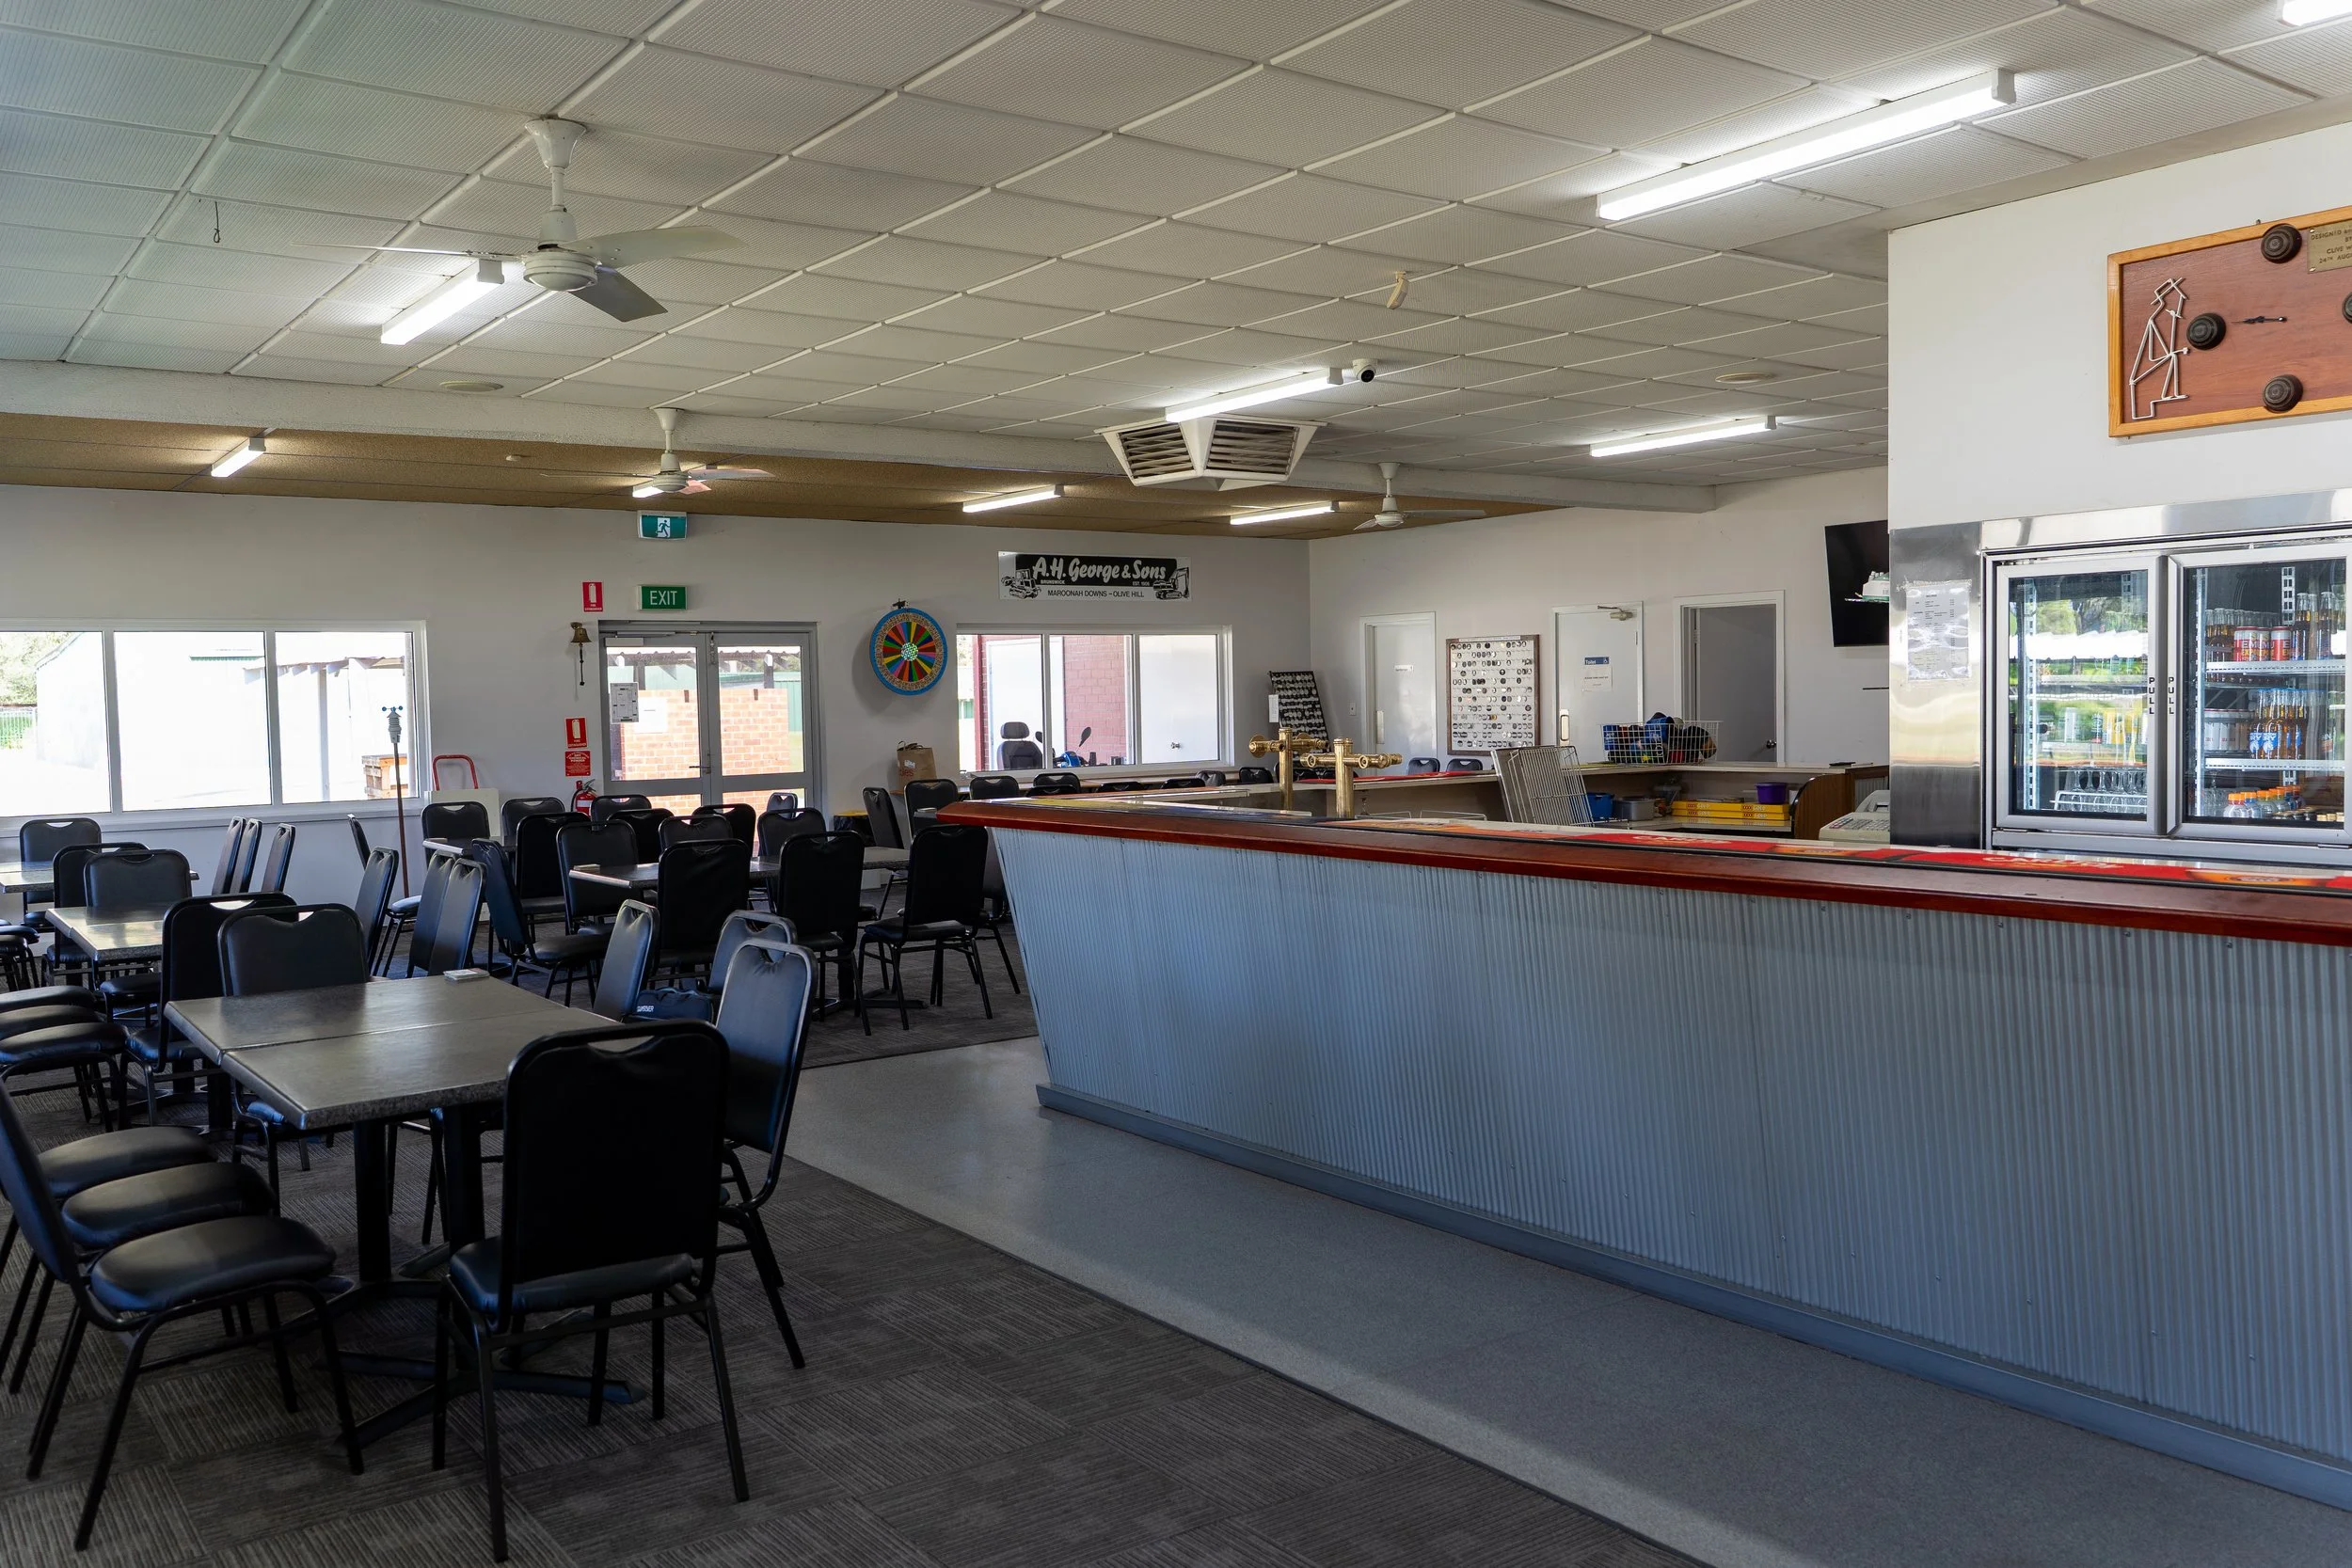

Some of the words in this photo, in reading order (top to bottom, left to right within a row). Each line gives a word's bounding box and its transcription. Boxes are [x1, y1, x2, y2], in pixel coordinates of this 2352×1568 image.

[2327, 245, 2344, 254] CLIVE
[1033, 557, 1066, 580] A.H.
[1069, 558, 1120, 583] George
[1121, 564, 1131, 578] &
[1133, 560, 1166, 579] Sons
[650, 591, 677, 605] EXIT
